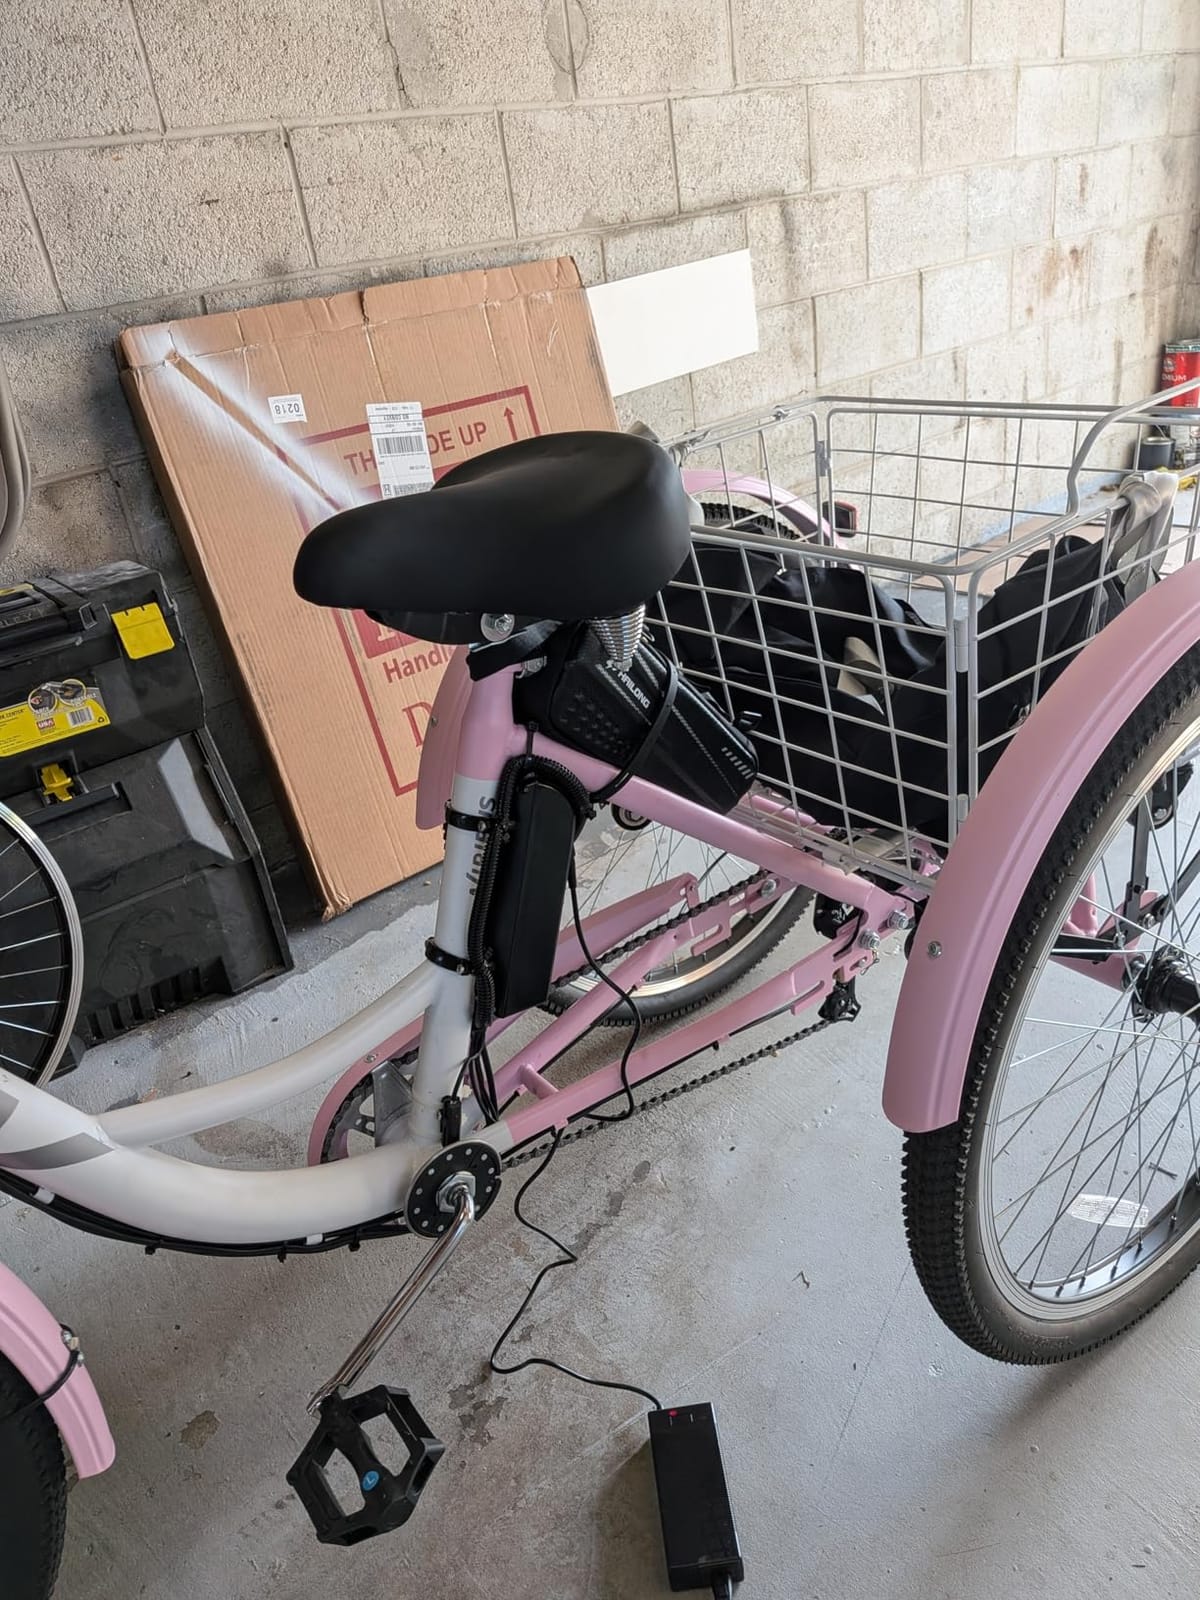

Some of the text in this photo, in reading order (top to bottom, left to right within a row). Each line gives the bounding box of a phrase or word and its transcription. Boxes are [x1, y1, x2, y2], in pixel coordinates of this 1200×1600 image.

[274, 403, 300, 415] 0218
[344, 421, 488, 475] TH DE UP
[382, 644, 449, 684] Handl
[617, 671, 651, 709] HAILONG
